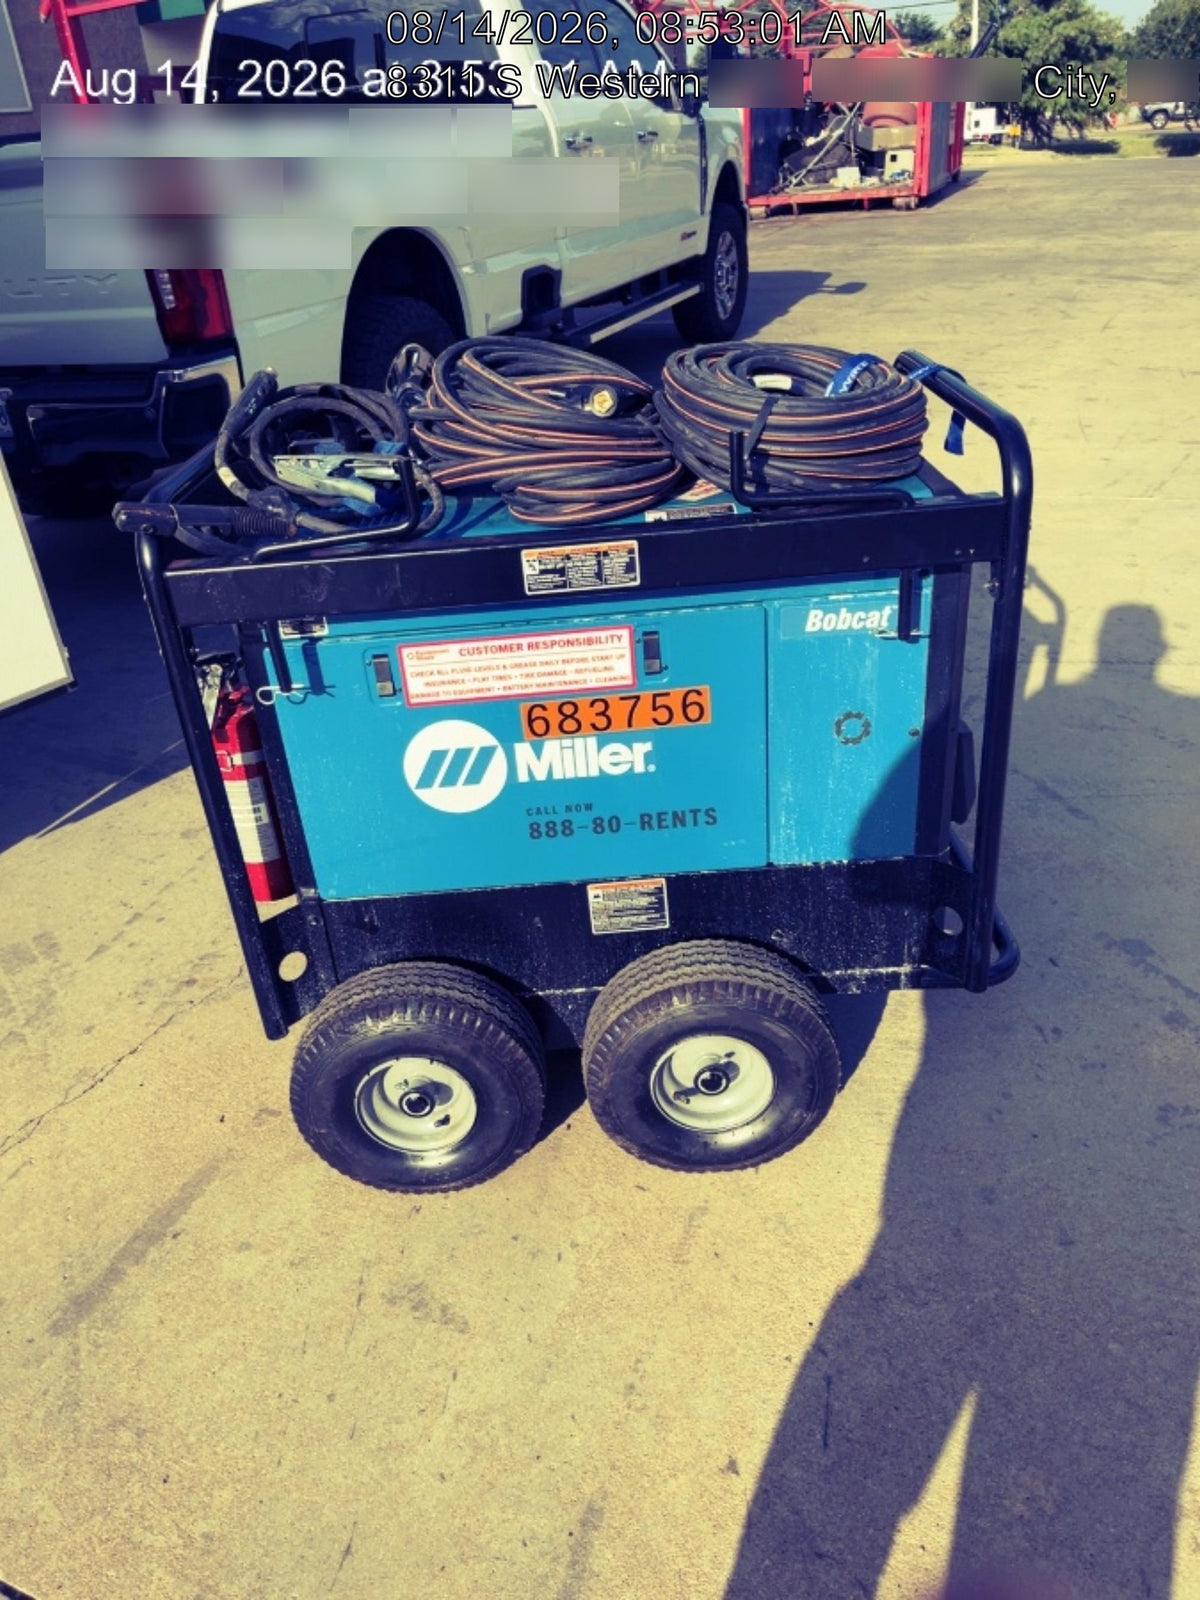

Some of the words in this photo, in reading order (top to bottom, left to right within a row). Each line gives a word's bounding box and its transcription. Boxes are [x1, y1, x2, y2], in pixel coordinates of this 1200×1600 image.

[805, 605, 892, 632] Bobcat
[458, 643, 524, 657] CUSTOMER
[527, 634, 623, 651] RESPONSIBILITY
[527, 689, 705, 737] 683756
[526, 805, 559, 817] CALL
[565, 803, 594, 814] NOW
[528, 807, 718, 840] 888-80-RENTS
